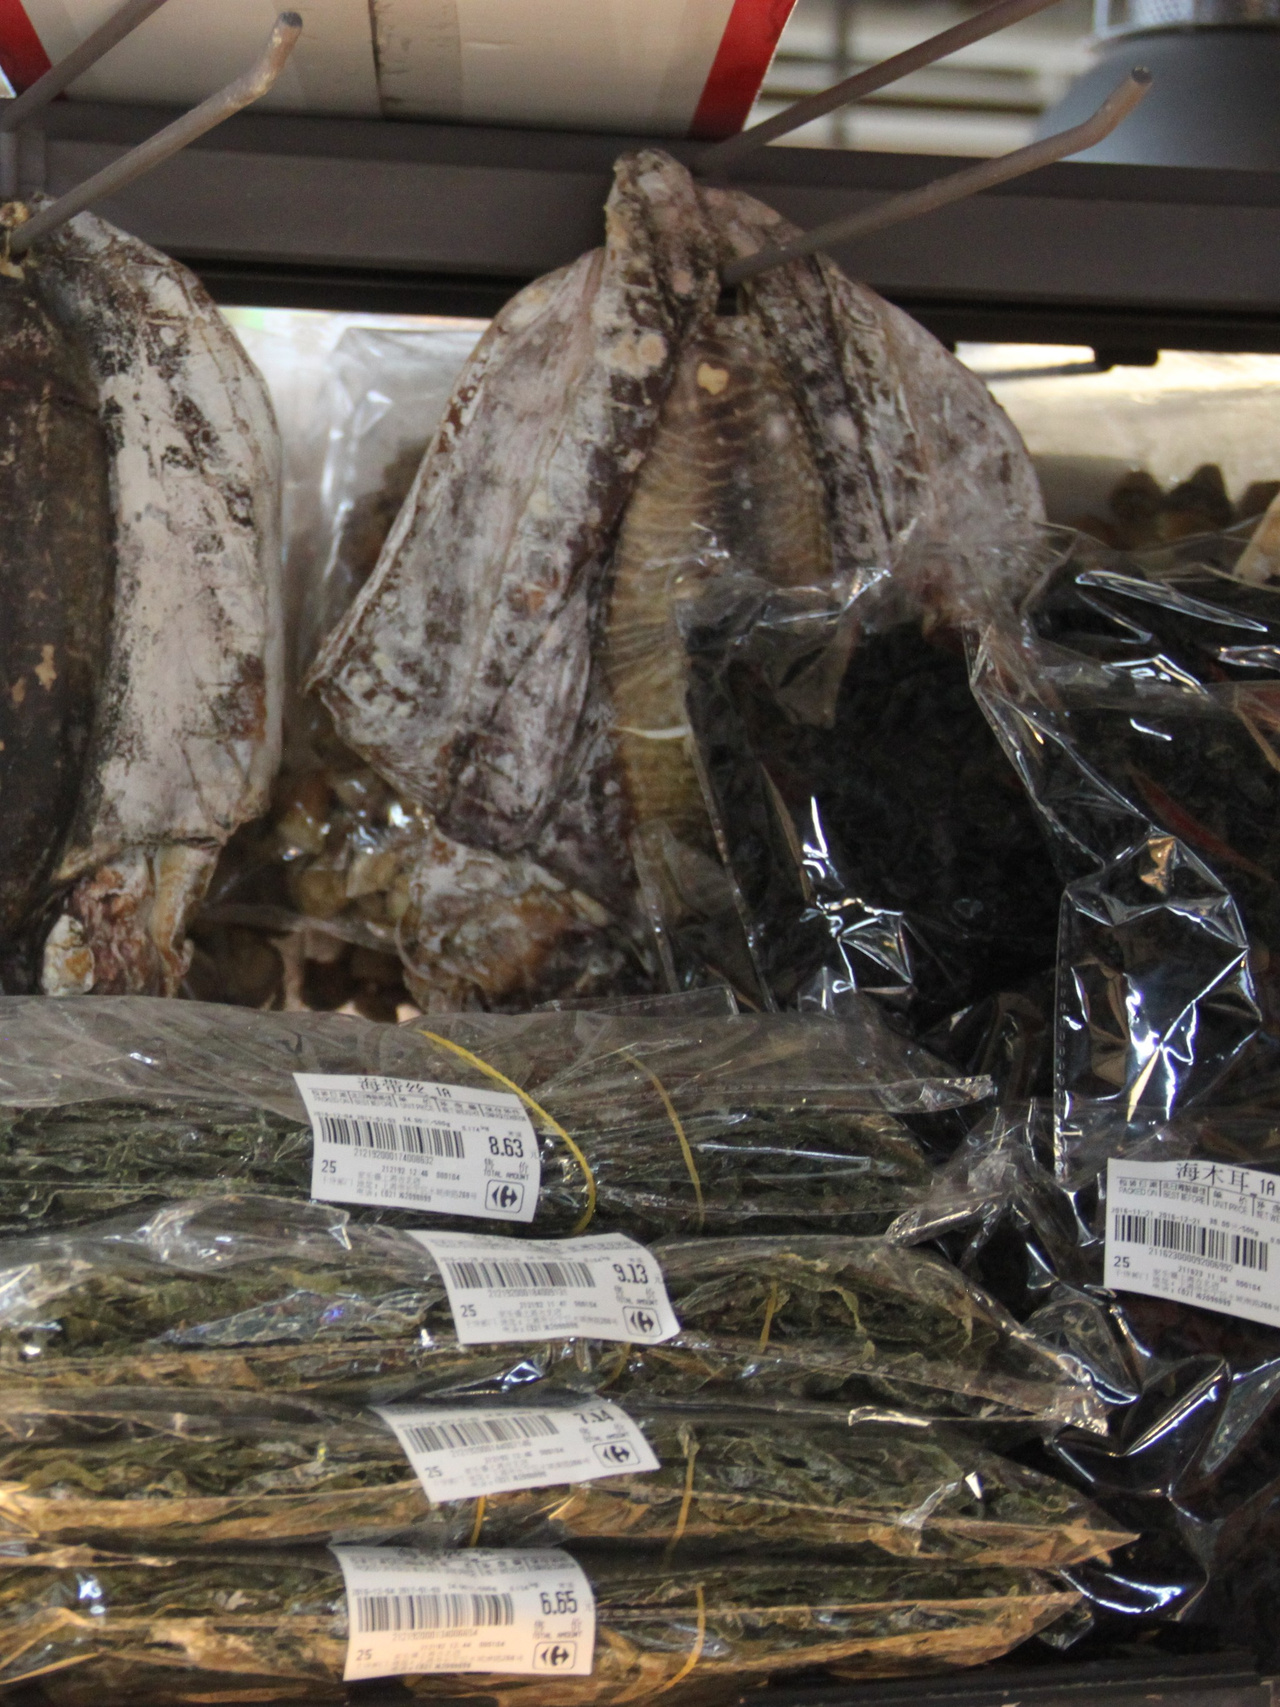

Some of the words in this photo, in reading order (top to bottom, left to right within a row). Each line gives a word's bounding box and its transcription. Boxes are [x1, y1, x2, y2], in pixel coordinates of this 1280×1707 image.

[436, 1087, 452, 1099] 1A
[487, 1136, 525, 1159] 8.63
[321, 1159, 337, 1174] 25
[1176, 1162, 1251, 1194] 海木耳
[1260, 1178, 1276, 1197] 1A
[1113, 1255, 1131, 1269] 25
[612, 1263, 649, 1285] 9.13
[460, 1304, 477, 1318] 25
[424, 1465, 443, 1480] 25
[538, 1590, 578, 1616] 6.65
[356, 1648, 374, 1662] 25
